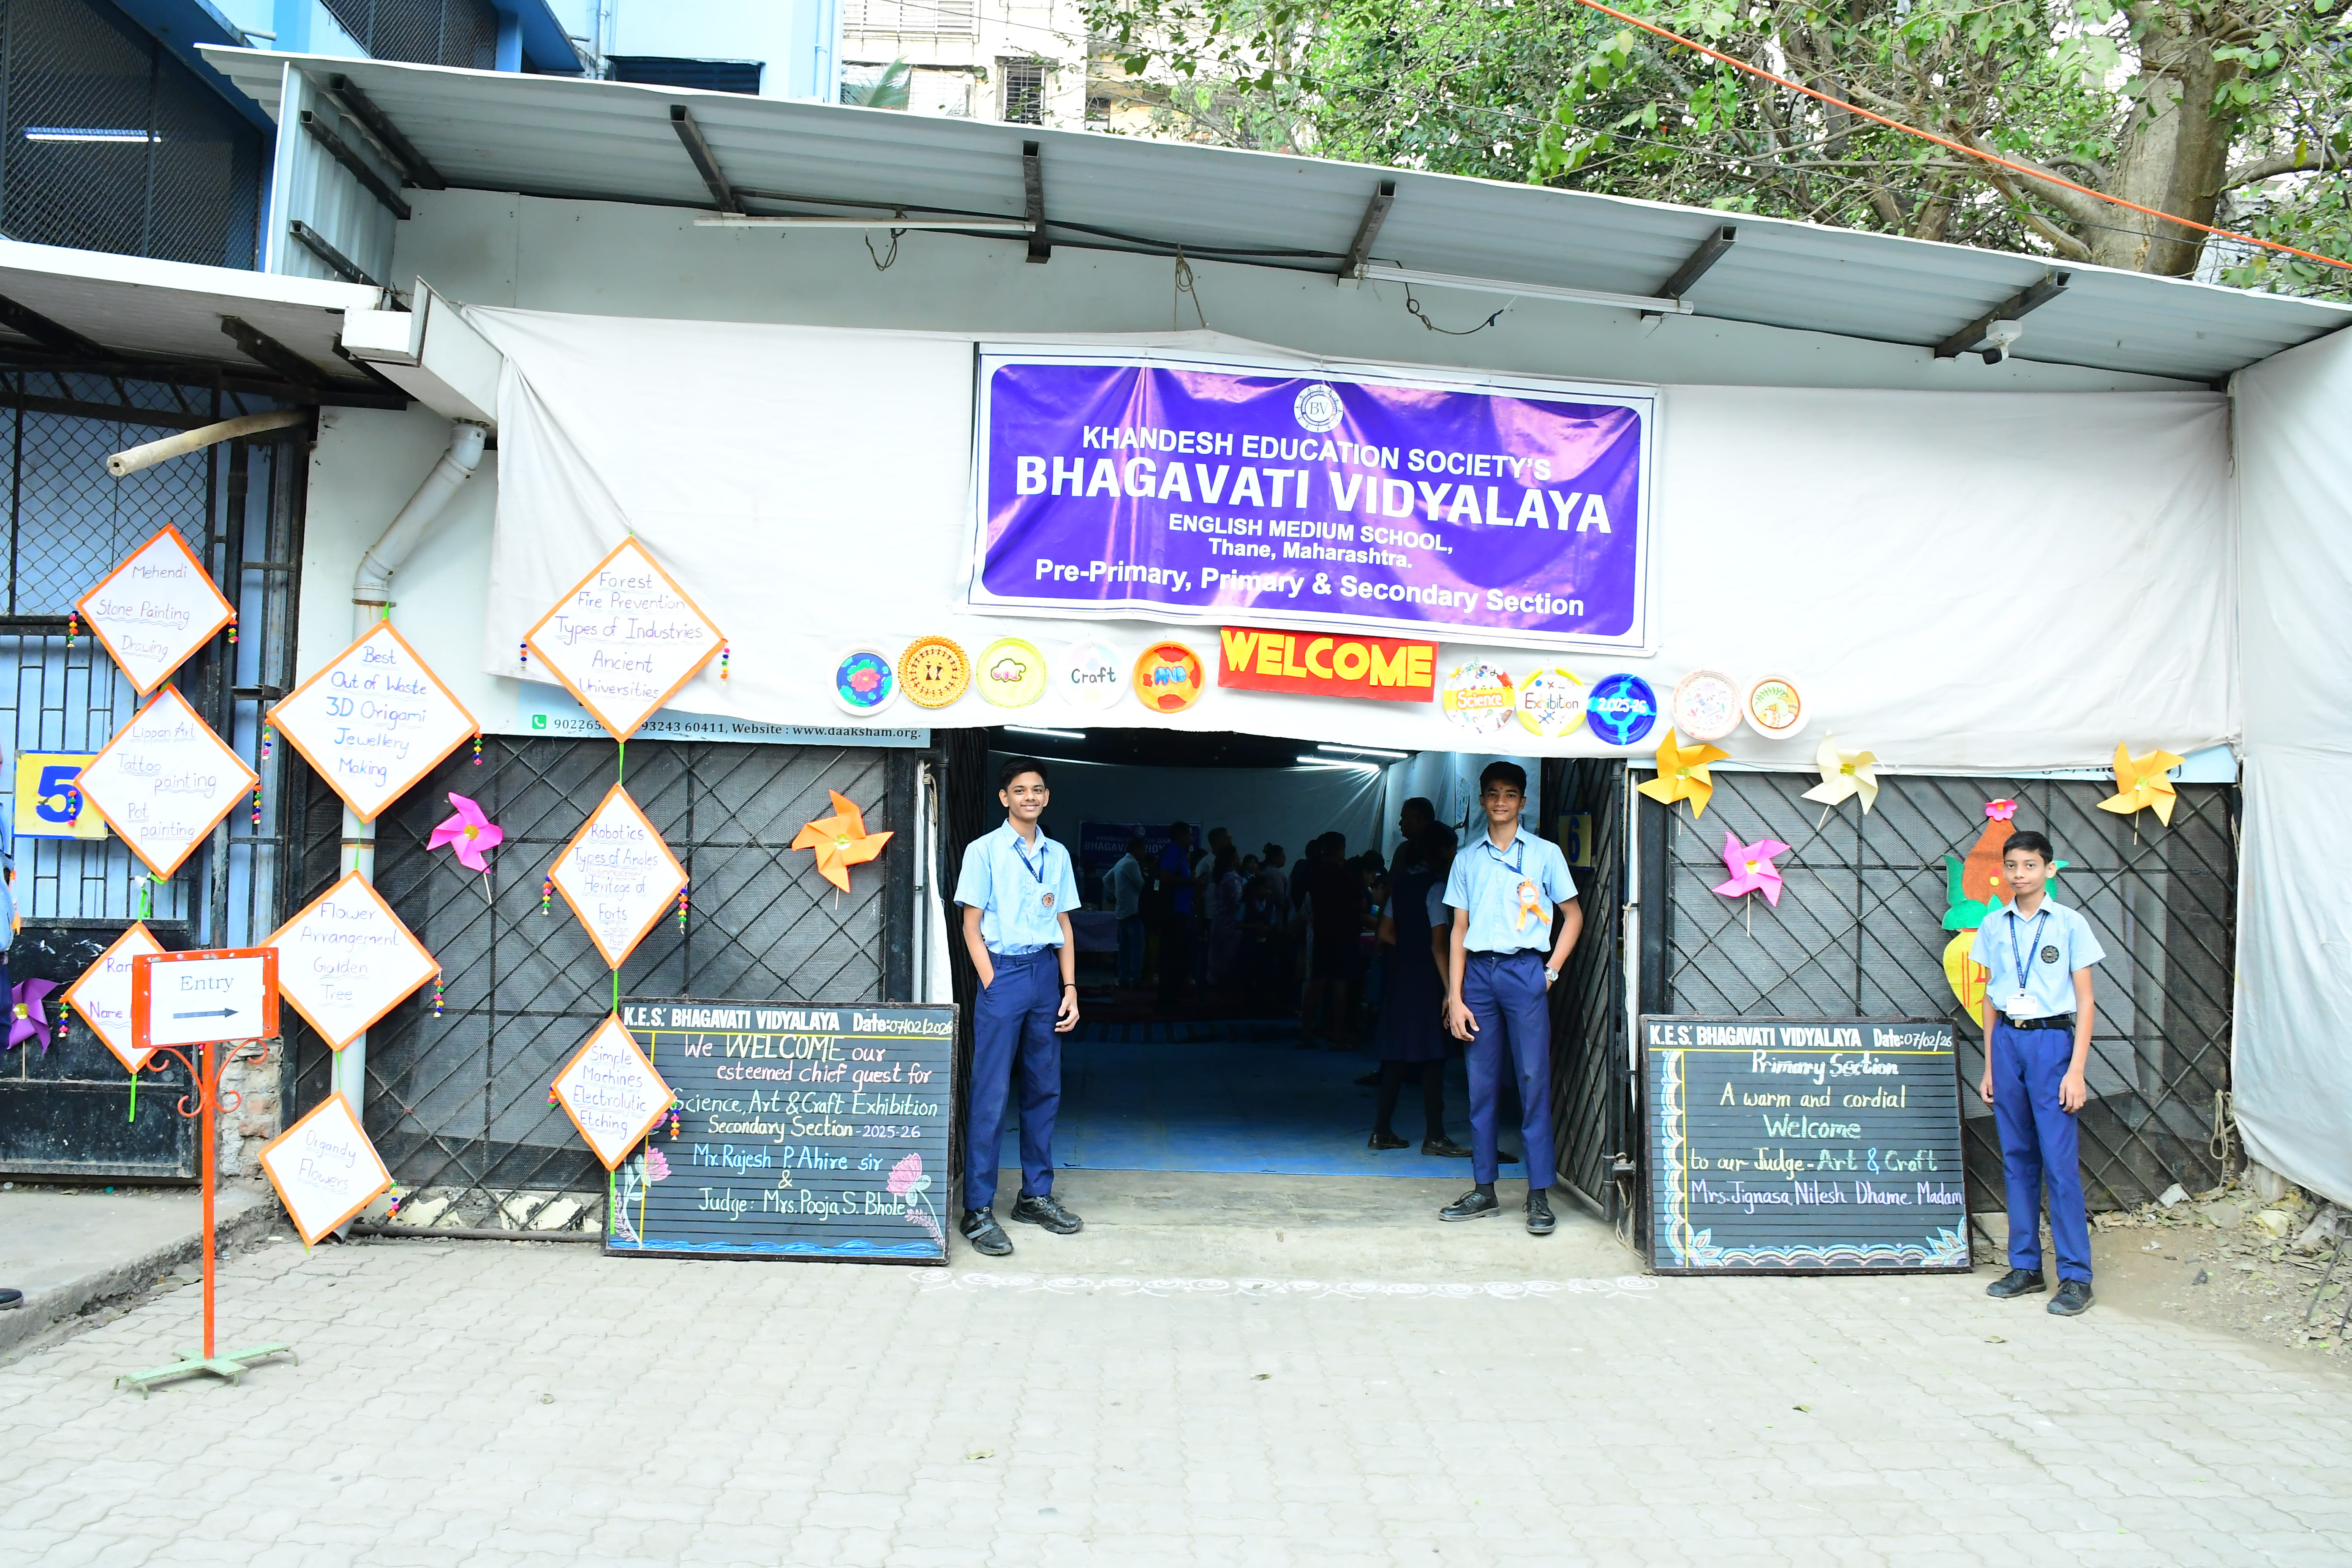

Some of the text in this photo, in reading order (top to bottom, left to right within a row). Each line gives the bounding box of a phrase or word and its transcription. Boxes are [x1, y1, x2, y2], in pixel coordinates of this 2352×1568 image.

[1309, 402, 1328, 414] BV
[1083, 426, 1551, 481] KHANDESH EDUCATION SOCIETY'S
[1016, 456, 1612, 533] BHAGAVATI VIDYALAYA
[1169, 514, 1453, 555] ENGLISH MEDIUM SCHOOL,
[1209, 538, 1412, 568] Thane, Maharashtra.
[132, 564, 187, 579] Mehendi
[600, 572, 653, 588] Forest
[578, 592, 685, 609] Fire Prevention
[1036, 561, 1584, 617] Pre-Primary, Primary & Secondary Section
[96, 599, 190, 629] Stone Painting
[555, 616, 703, 645] Types of Industries
[121, 635, 168, 662] Drawing
[362, 646, 396, 664] Best
[1221, 629, 1433, 687] WELCOME
[592, 650, 653, 673] Ancient
[331, 671, 427, 694] Out of Waste
[1072, 667, 1116, 685] Craft
[1154, 665, 1186, 685] AND
[580, 678, 659, 698] Universities
[1457, 691, 1503, 708] Science
[327, 696, 427, 730] 3D Origami
[1525, 692, 1578, 710] Exhibition
[1598, 697, 1647, 714] 2025-26
[132, 721, 196, 745] Lippan Art
[554, 719, 607, 730] 902265
[641, 720, 680, 732] 93243
[685, 722, 728, 734] 60411,
[732, 723, 782, 735] Website
[793, 725, 921, 740] www.daaksham.org.
[335, 727, 409, 759] Jewellery
[117, 754, 161, 772] Tattoo
[339, 757, 387, 787] Making
[36, 765, 83, 822] 5
[155, 773, 216, 798] painting
[128, 802, 149, 818] Pot
[141, 822, 195, 845] painting
[591, 823, 644, 840] Robotics
[1568, 816, 1580, 863] 6
[575, 847, 658, 875] Types of Angles
[585, 875, 646, 901] Heritage of
[321, 902, 376, 920] Flower
[599, 903, 627, 920] Forts
[300, 926, 399, 953] Arrangement
[314, 957, 368, 974] Golden
[180, 976, 234, 992] Entry
[320, 984, 353, 1000] Tree
[90, 1001, 122, 1018] Name
[671, 1008, 751, 1029] BHAGAVATI
[756, 1010, 840, 1031] VIDYALAYA
[685, 1034, 886, 1062] We WELCOME our
[1696, 1026, 1775, 1047] BHAGAVATI
[1779, 1027, 1862, 1047] VIDYALAYA
[591, 1046, 632, 1070] Simple
[1752, 1049, 1899, 1085] Primary Section
[583, 1065, 642, 1087] Machines
[717, 1060, 932, 1093] esteemed chief guest for
[573, 1085, 646, 1117] Electrolytic
[852, 1092, 938, 1116] Exhibition
[1720, 1082, 1905, 1108] A warm and cordial
[580, 1111, 627, 1140] Etching
[708, 1115, 785, 1142] Secondary
[791, 1115, 852, 1137] Section
[1763, 1113, 1861, 1140] Welcome
[858, 1153, 883, 1171] sir
[1689, 1148, 1709, 1170] to
[1718, 1157, 1749, 1171] our
[1867, 1147, 1880, 1175] &
[1885, 1149, 1938, 1172] Craft
[299, 1158, 348, 1190] Flowers
[778, 1170, 793, 1189] &
[843, 1192, 859, 1214] S.
[865, 1191, 906, 1215] Bhole
[1794, 1180, 1847, 1206] Nilesh
[1856, 1181, 1912, 1206] Dhame
[1917, 1181, 1963, 1205] Madam
